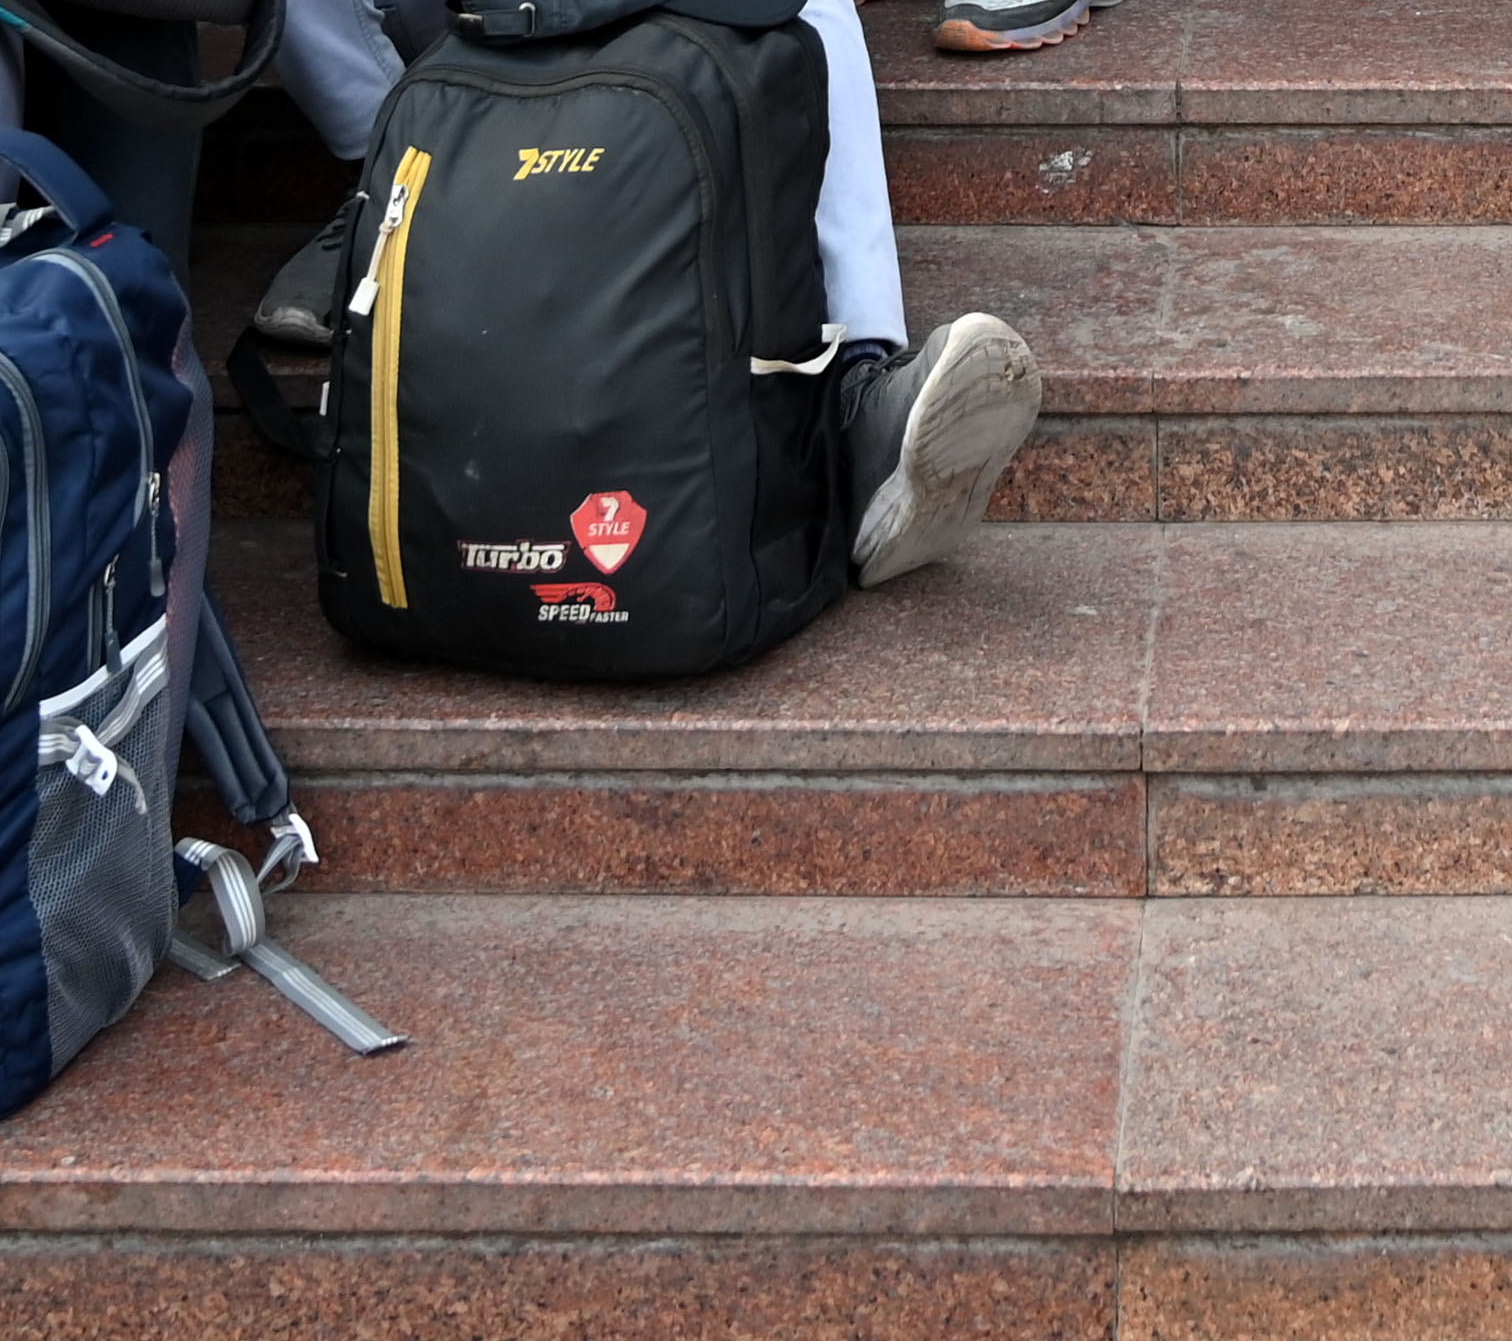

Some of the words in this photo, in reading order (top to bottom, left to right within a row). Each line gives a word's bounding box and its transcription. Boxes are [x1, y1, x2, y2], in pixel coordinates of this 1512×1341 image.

[599, 496, 620, 522] 7
[588, 521, 631, 537] STYLE
[461, 540, 565, 571] Turbo
[538, 604, 591, 623] SPEED
[590, 611, 630, 623] FASTER
